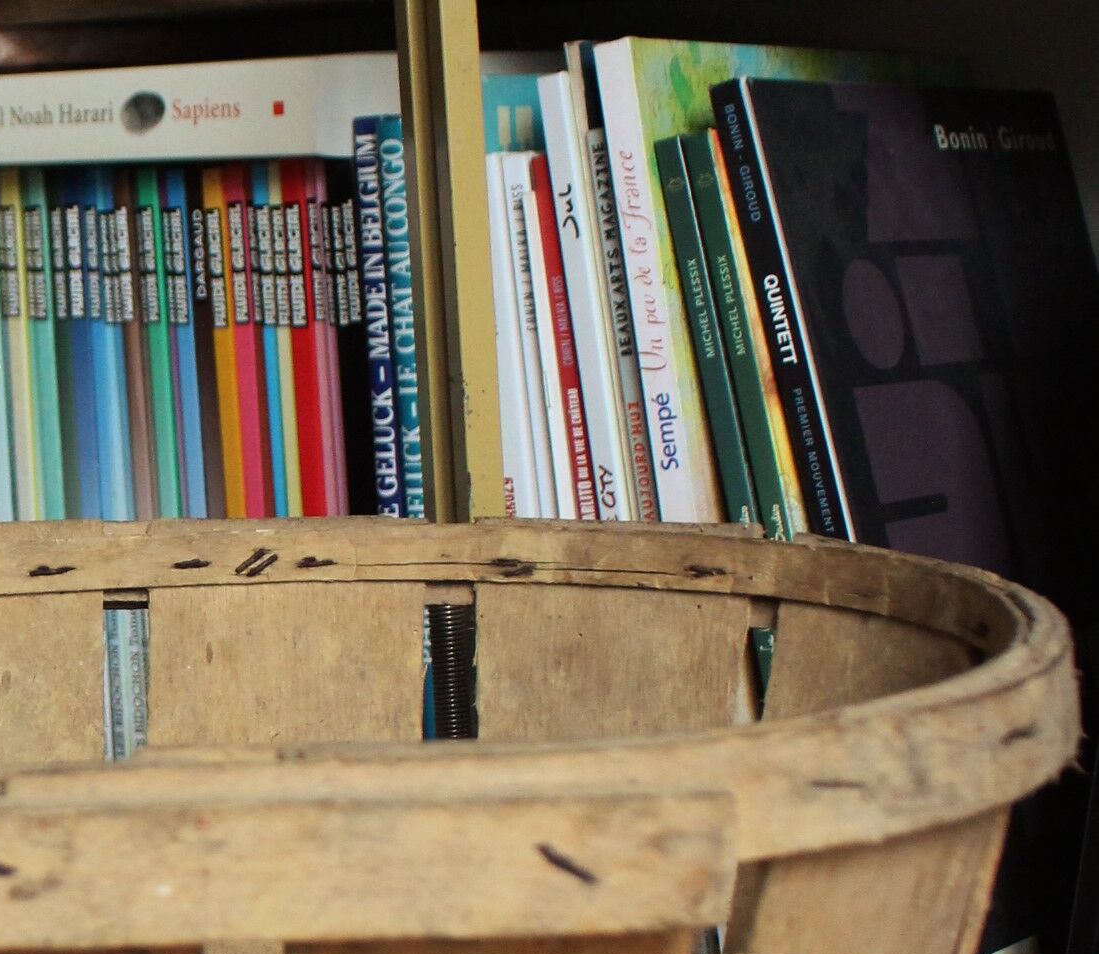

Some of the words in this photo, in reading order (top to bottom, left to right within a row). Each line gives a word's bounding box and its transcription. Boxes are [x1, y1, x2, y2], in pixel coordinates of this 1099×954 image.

[10, 103, 53, 126] Noah
[58, 101, 113, 124] Harari
[171, 98, 241, 126] Sapiens
[934, 124, 988, 149] Bonin
[355, 135, 384, 246] BELGIUM
[379, 139, 408, 236] CONGO
[592, 142, 619, 241] MAGAZINE
[618, 150, 652, 229] France
[192, 209, 207, 299] DARGAUD
[206, 209, 223, 276] GLACIAL
[229, 203, 245, 271] GLACIAL
[257, 205, 272, 273] GLACIAL
[286, 204, 302, 274] GLACIAL
[387, 241, 412, 278] AU
[628, 236, 647, 254] la
[363, 252, 385, 279] IN
[606, 246, 625, 295] ARTS
[633, 266, 652, 286] de
[686, 257, 705, 308] PLESSIX
[716, 254, 735, 304] PLESSIX
[211, 277, 228, 327] FLUIDE
[233, 272, 249, 323] FLUIDE
[261, 274, 277, 325] FLUIDE
[290, 274, 307, 326] FLUIDE
[365, 282, 391, 359] MADE
[391, 281, 416, 354] CHAT
[644, 294, 667, 324] peu
[724, 104, 744, 150] BONIN
[739, 165, 761, 222] GIROUD
[763, 273, 798, 365] QUINTETT
[792, 388, 813, 448] PREMIER
[808, 450, 834, 534] MOUVEMENT
[613, 297, 633, 356] BEAUX
[699, 309, 715, 359] MICHEL
[728, 304, 745, 355] MICHEL
[639, 338, 668, 370] Un
[568, 387, 582, 427] CHÂTEAU
[572, 427, 584, 438] DE
[651, 392, 679, 470] Sempé
[371, 387, 399, 498] GELUCK
[574, 439, 586, 452] VIE
[576, 453, 587, 465] LA
[577, 480, 597, 520] ARLITO
